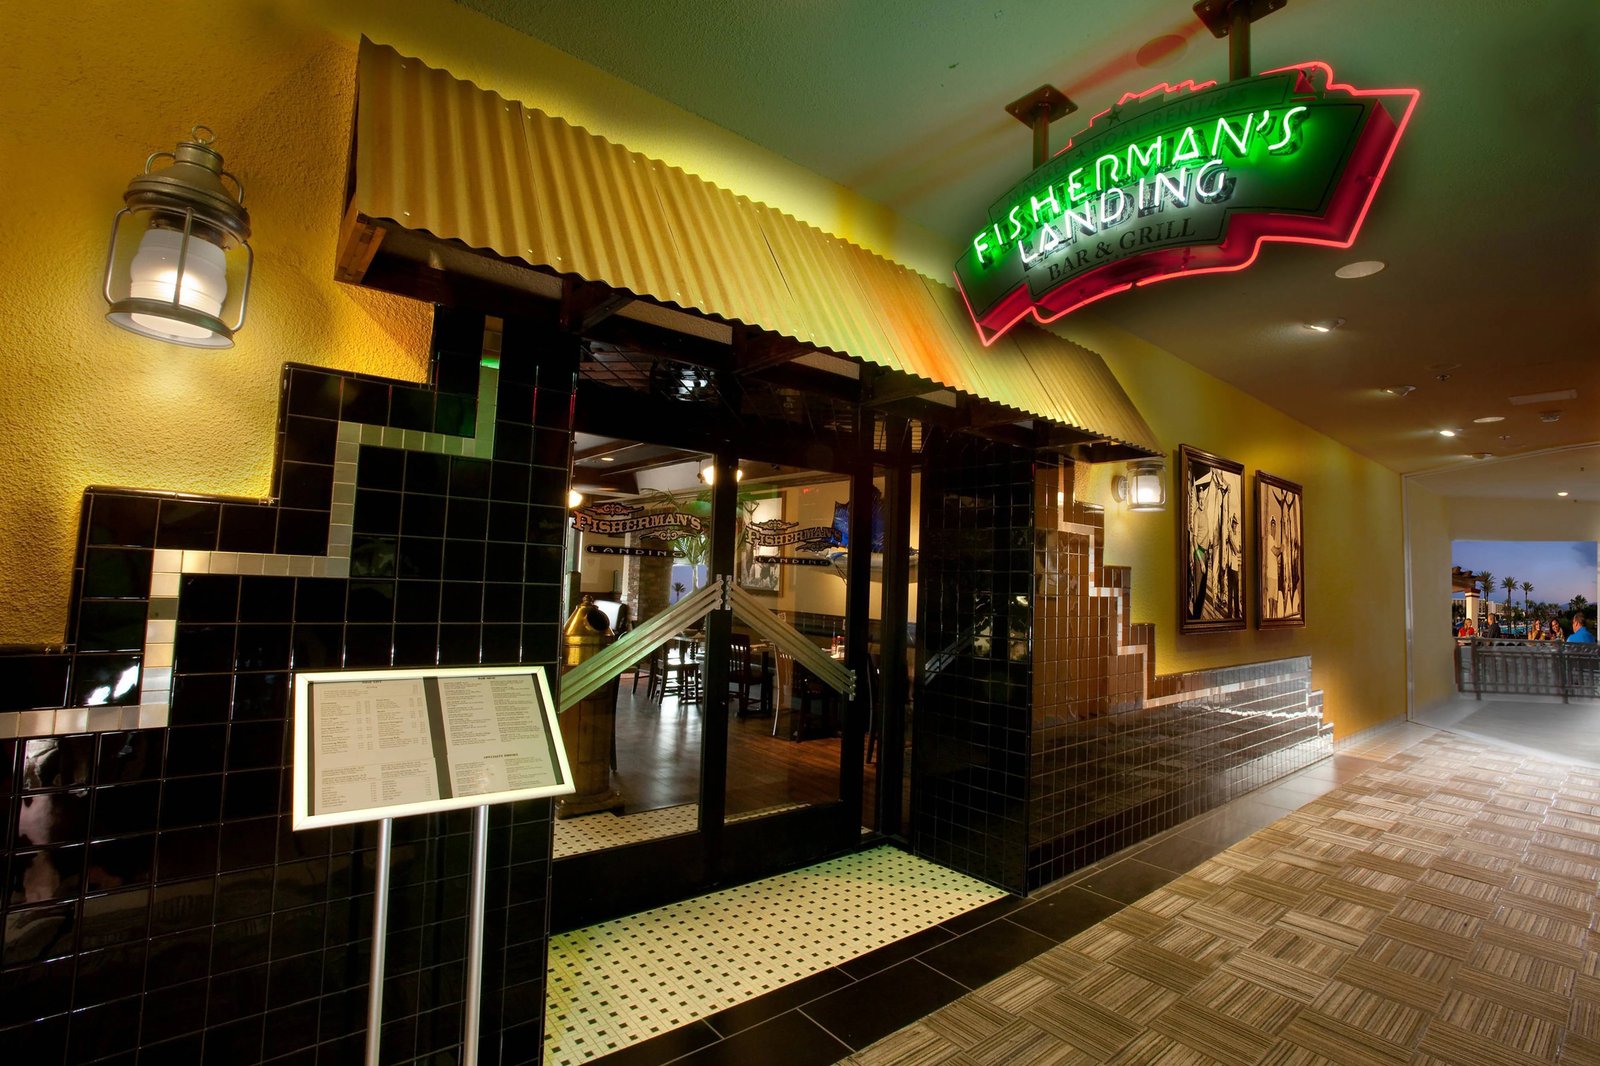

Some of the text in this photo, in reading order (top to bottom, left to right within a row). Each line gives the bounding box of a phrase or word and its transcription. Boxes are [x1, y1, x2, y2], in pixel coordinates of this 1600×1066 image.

[974, 106, 1309, 268] FISHERMAN'S
[1018, 160, 1235, 271] LANDING
[1048, 218, 1196, 281] BAR & GRILL
[591, 546, 683, 558] LANDING
